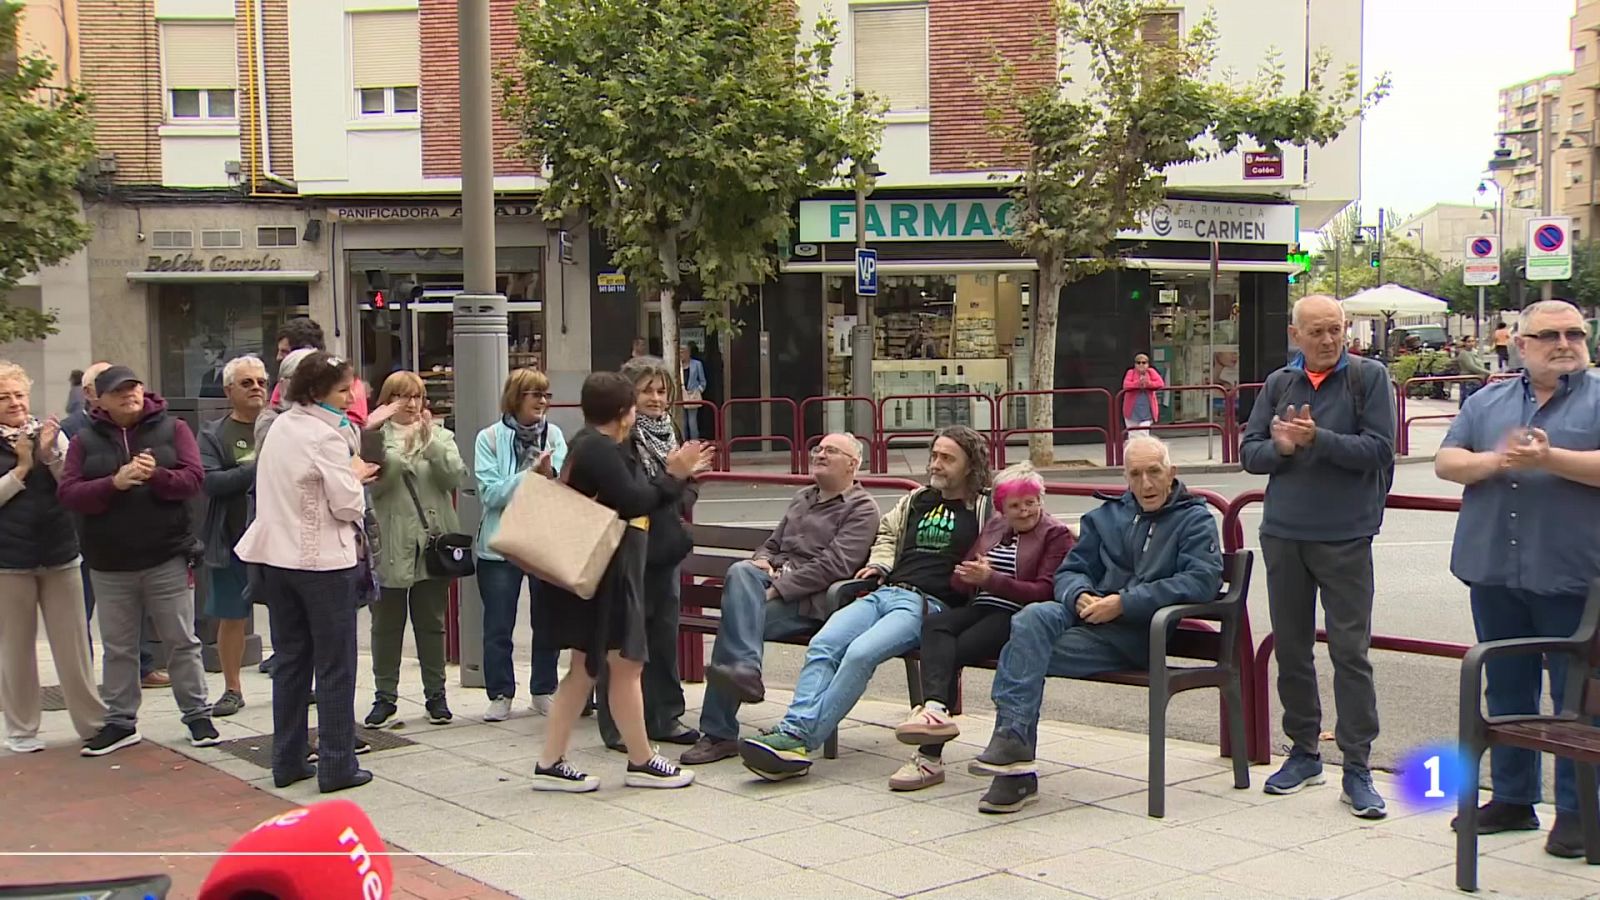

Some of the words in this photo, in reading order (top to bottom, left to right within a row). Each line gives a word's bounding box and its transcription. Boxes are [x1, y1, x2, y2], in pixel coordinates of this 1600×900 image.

[1251, 166, 1275, 174] Colón
[338, 207, 440, 219] PANIFICADORA
[1177, 203, 1265, 217] FARMACIA
[829, 202, 1017, 238] FARMAC
[1177, 219, 1194, 229] DEL
[1194, 219, 1266, 240] CARMEN
[338, 826, 383, 900] rne
